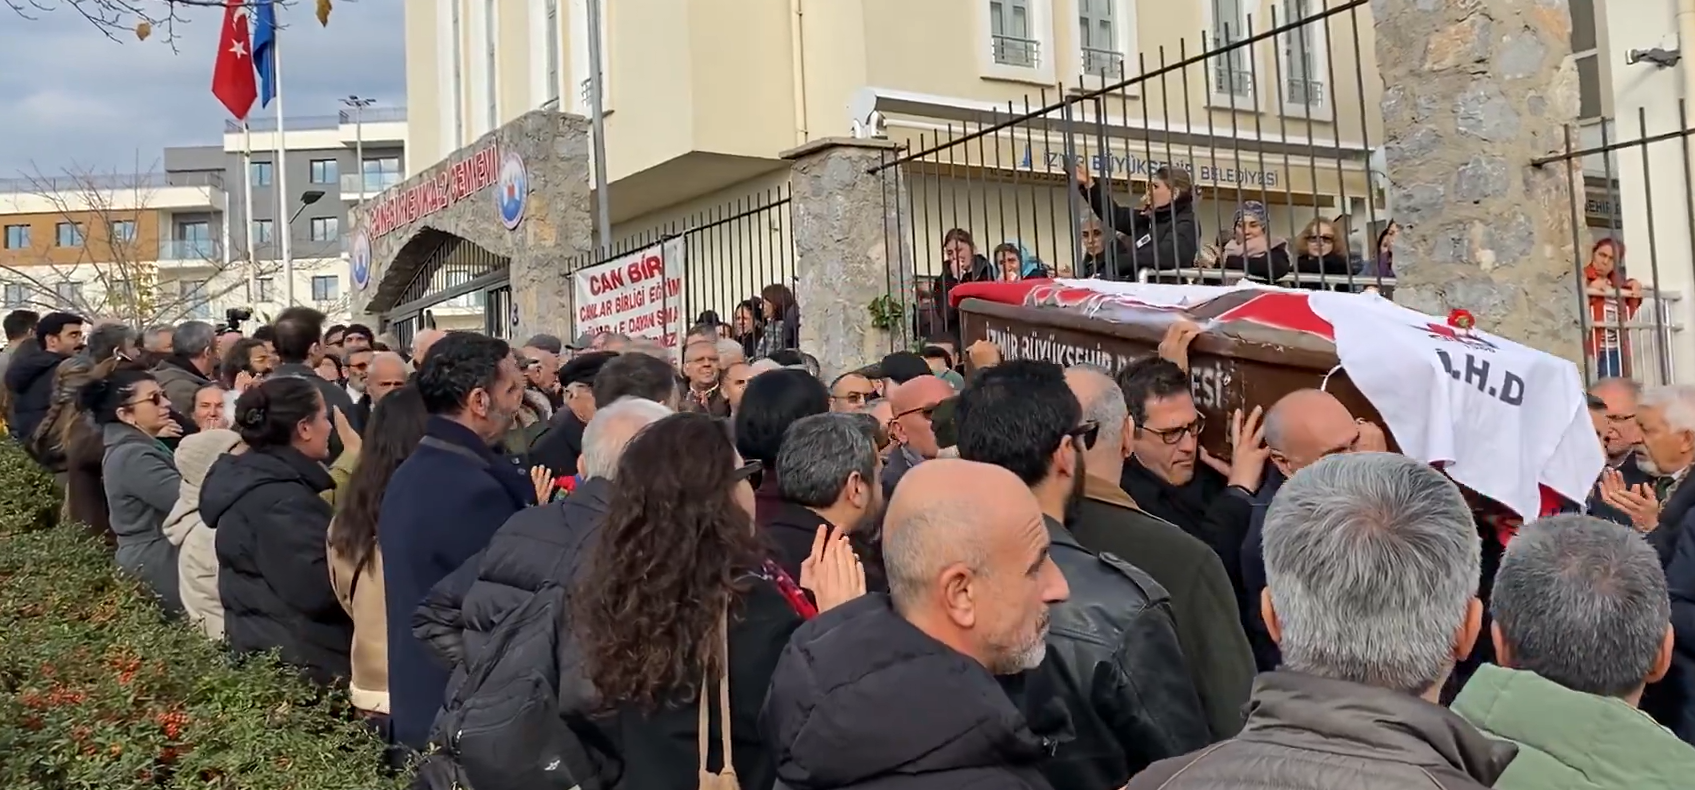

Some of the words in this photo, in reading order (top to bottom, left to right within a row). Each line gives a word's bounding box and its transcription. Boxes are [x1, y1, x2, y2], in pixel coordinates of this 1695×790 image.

[590, 267, 624, 296] CAN
[627, 253, 663, 284] BİR
[580, 300, 612, 321] CANLAR
